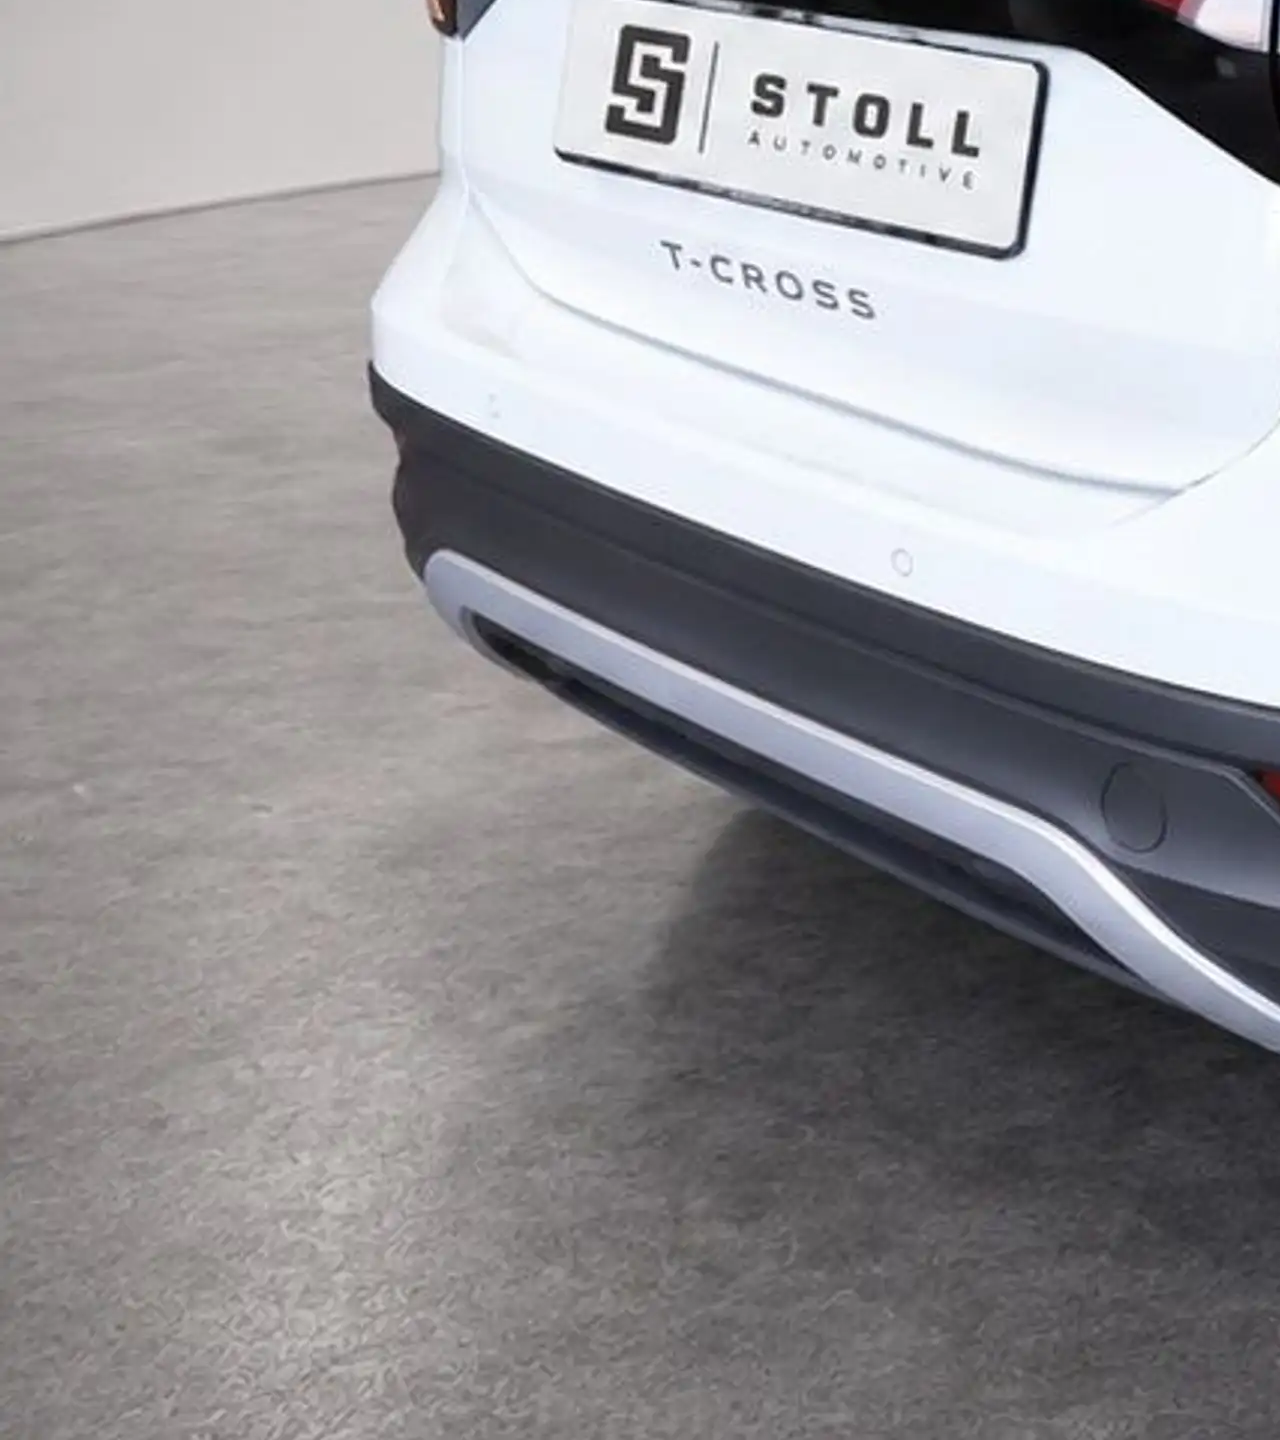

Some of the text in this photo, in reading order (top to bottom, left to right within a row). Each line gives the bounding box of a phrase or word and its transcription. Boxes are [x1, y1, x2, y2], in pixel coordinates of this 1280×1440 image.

[750, 73, 980, 158] STOLL
[747, 129, 974, 190] AUTOMOTIVE
[659, 240, 876, 321] T-CROSS
